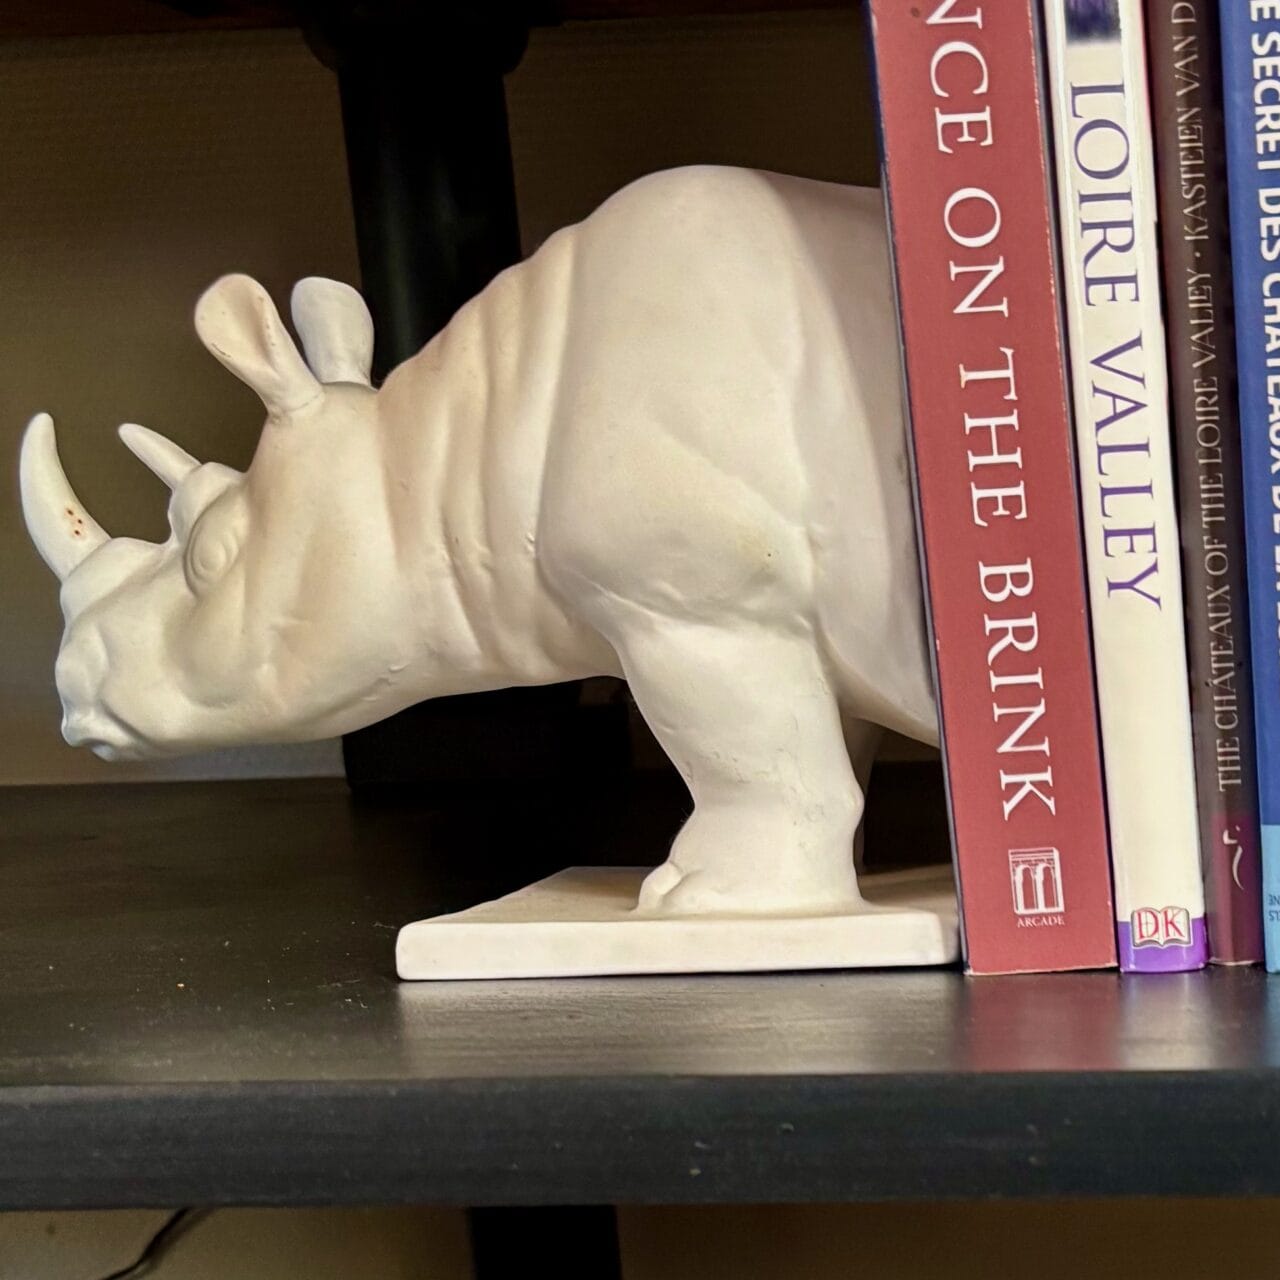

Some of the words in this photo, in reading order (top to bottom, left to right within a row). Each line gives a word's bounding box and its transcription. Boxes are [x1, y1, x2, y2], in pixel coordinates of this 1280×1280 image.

[1173, 35, 1201, 96] VAN
[1070, 82, 1142, 307] LOIRE
[943, 187, 1009, 317] ON
[1186, 267, 1218, 368] VALLEY
[958, 346, 1029, 527] THE
[1193, 375, 1224, 464] LOIRE
[1089, 330, 1162, 610] VALLEY
[1199, 472, 1227, 525] THE
[1203, 535, 1228, 576] OF
[978, 557, 1056, 821] BRINK
[1217, 735, 1242, 792] THE
[1016, 916, 1066, 928] ARCADE
[1137, 912, 1188, 940] DK
